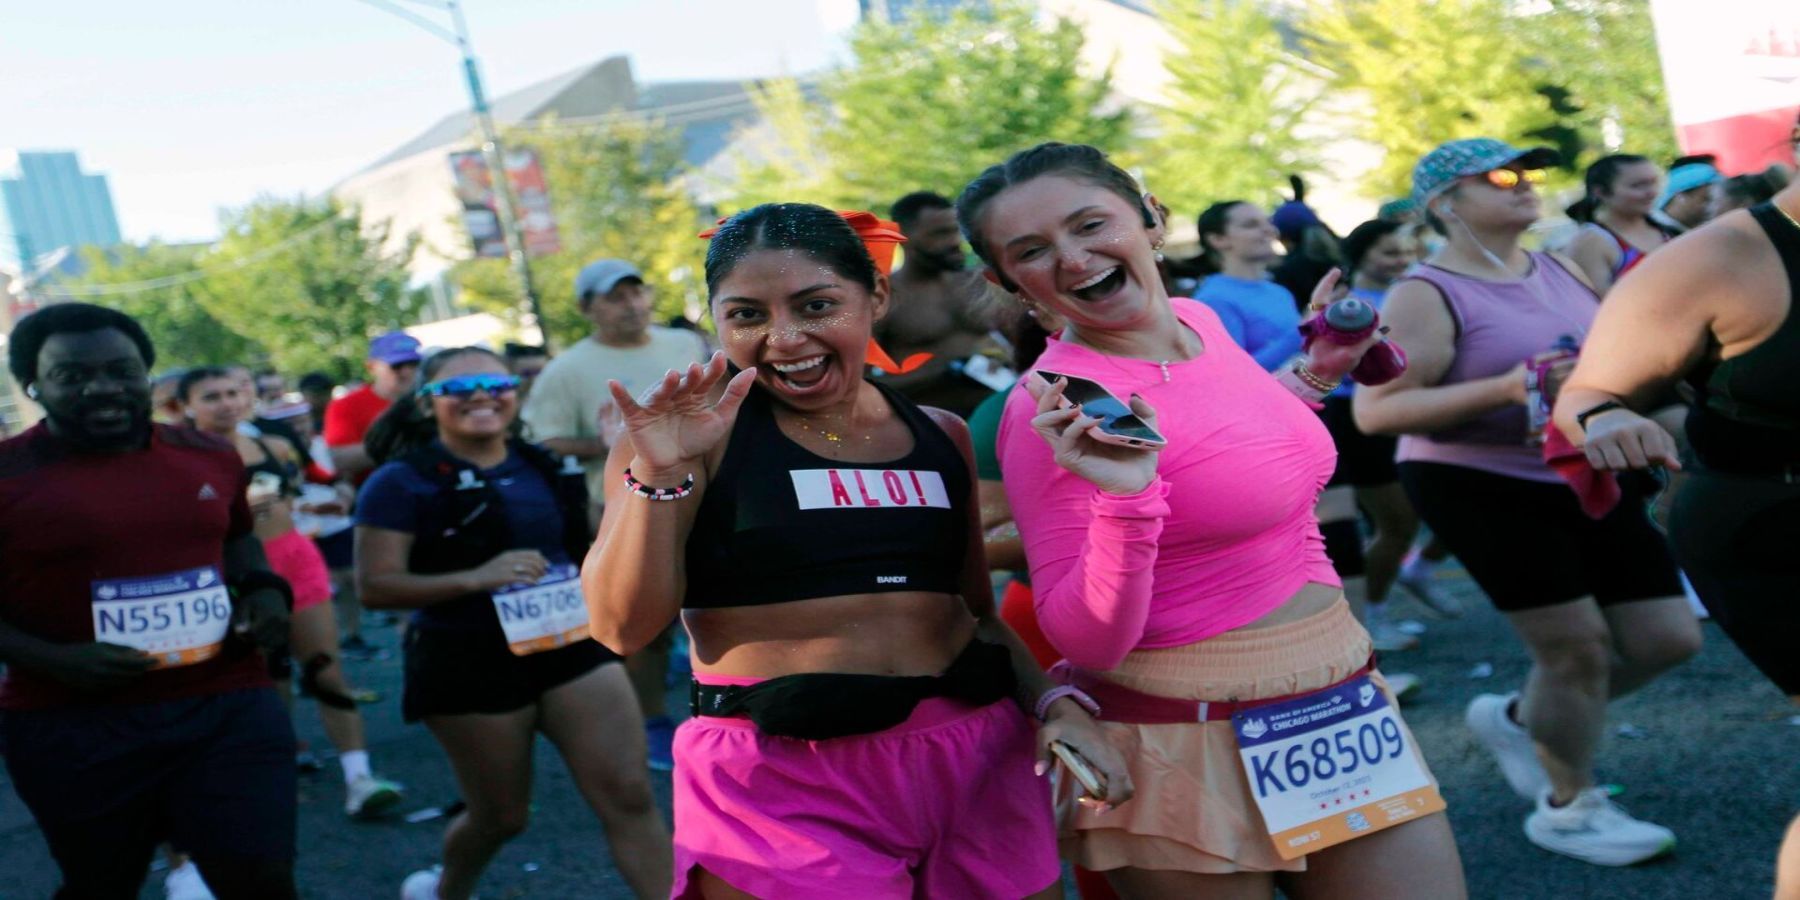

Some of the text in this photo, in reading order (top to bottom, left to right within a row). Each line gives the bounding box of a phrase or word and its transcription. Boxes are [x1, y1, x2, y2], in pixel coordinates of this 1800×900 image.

[828, 469, 928, 507] ALO!
[876, 576, 907, 584] BANDIT
[98, 594, 228, 633] N55196
[1272, 702, 1352, 731] CHICAGO MARATHON
[1251, 716, 1404, 798] K68509
